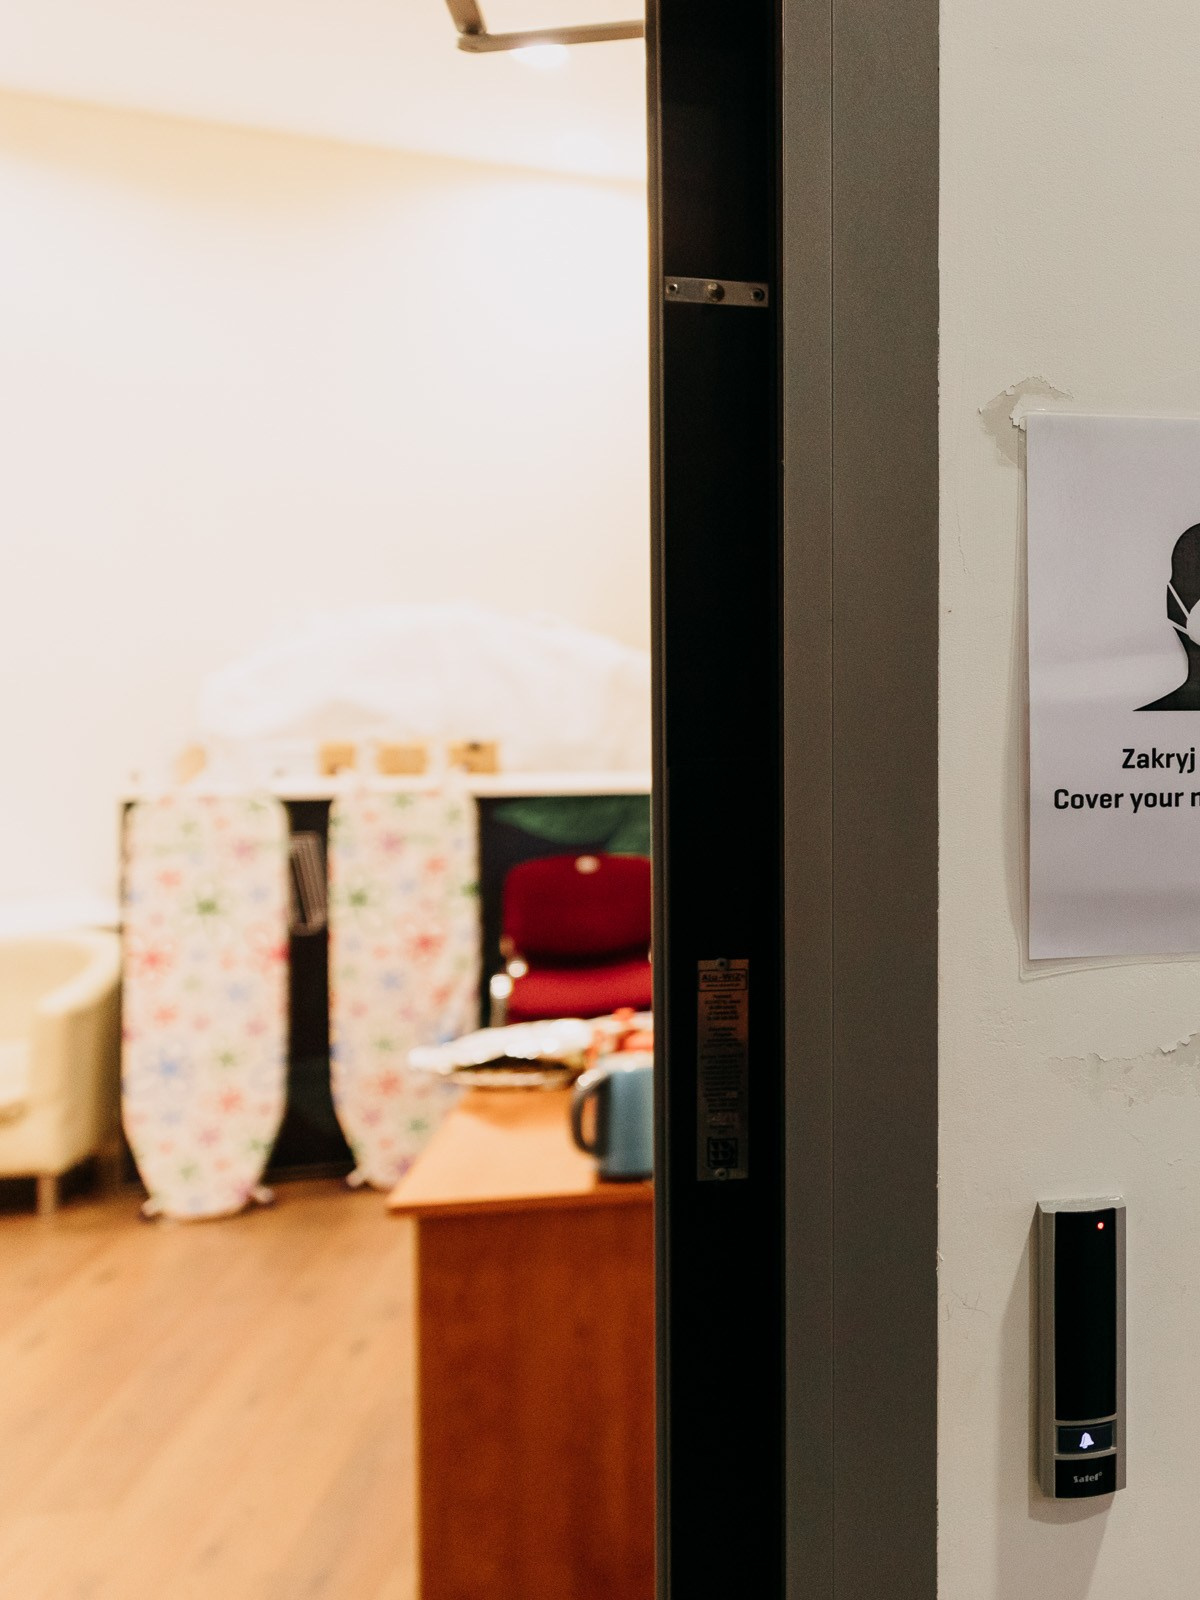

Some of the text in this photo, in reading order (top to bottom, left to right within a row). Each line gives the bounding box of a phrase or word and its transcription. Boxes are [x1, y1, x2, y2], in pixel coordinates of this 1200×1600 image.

[1121, 746, 1196, 774] Zakryj
[1053, 788, 1125, 810] Cover
[1129, 791, 1185, 814] your
